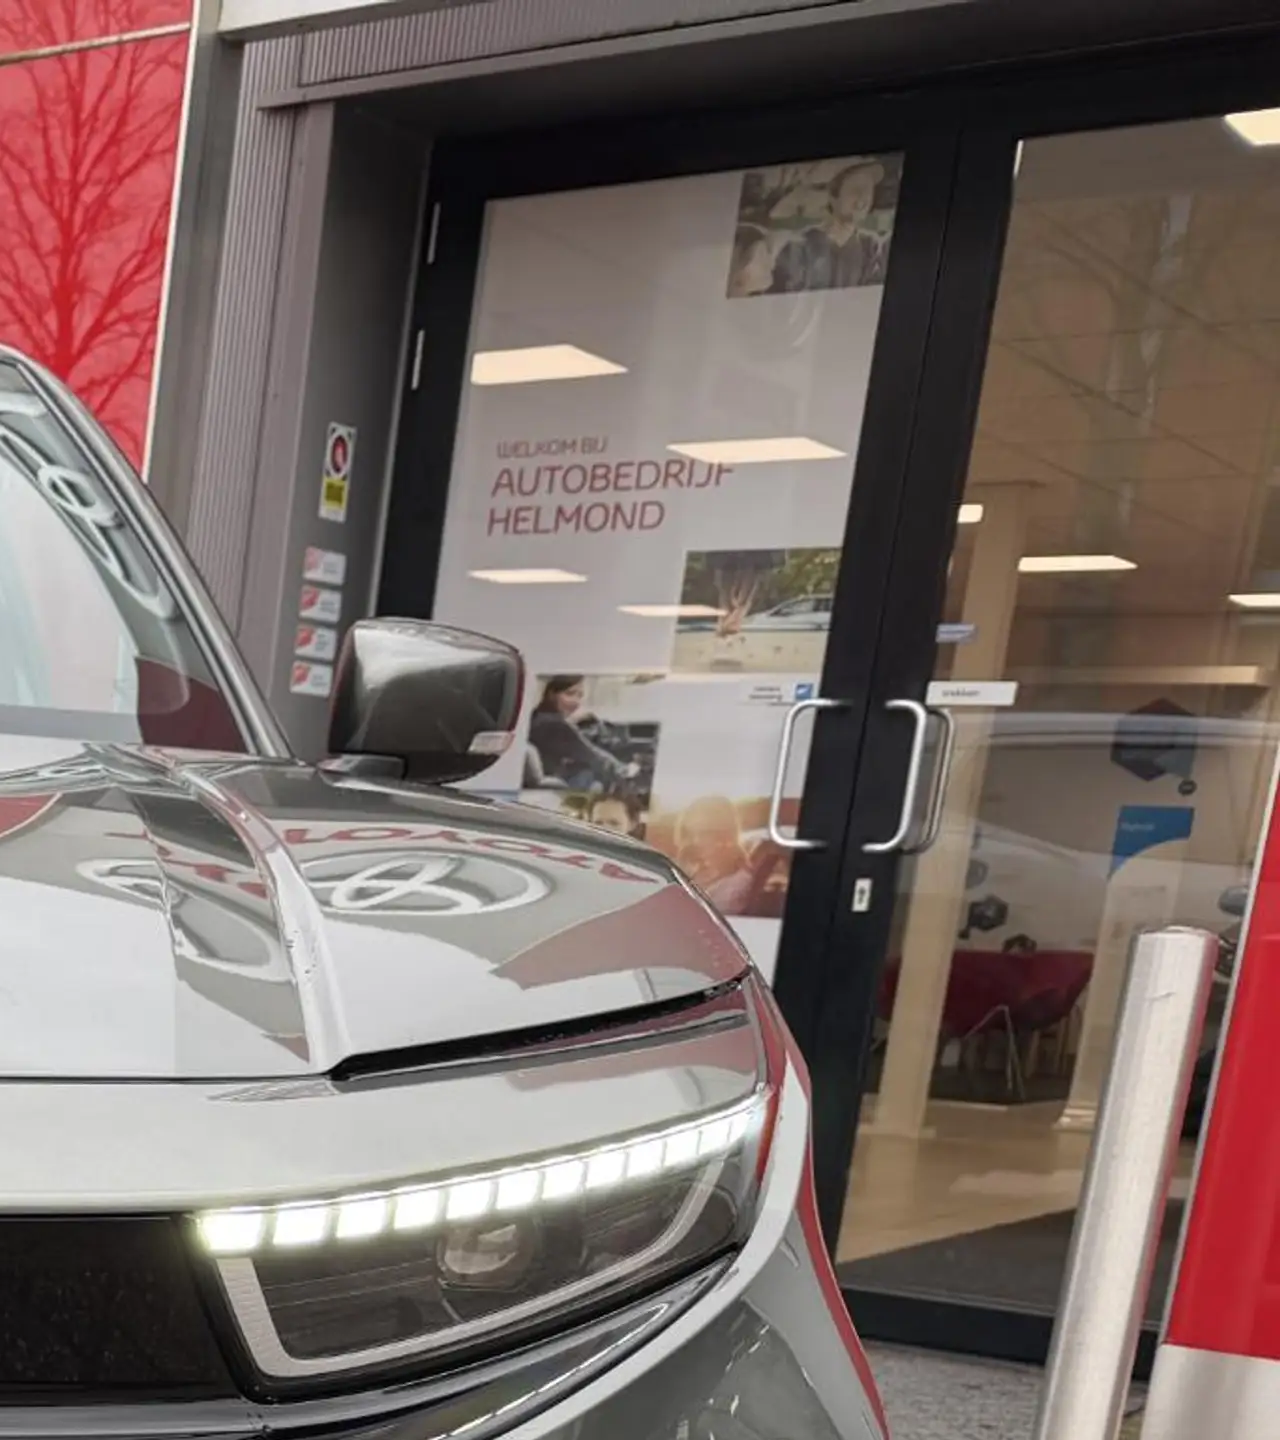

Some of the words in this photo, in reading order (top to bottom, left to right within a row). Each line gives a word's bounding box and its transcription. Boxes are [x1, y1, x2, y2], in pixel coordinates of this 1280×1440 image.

[497, 439, 578, 459] WELKOM
[581, 437, 608, 456] BIJ
[486, 501, 666, 537] HELMOND
